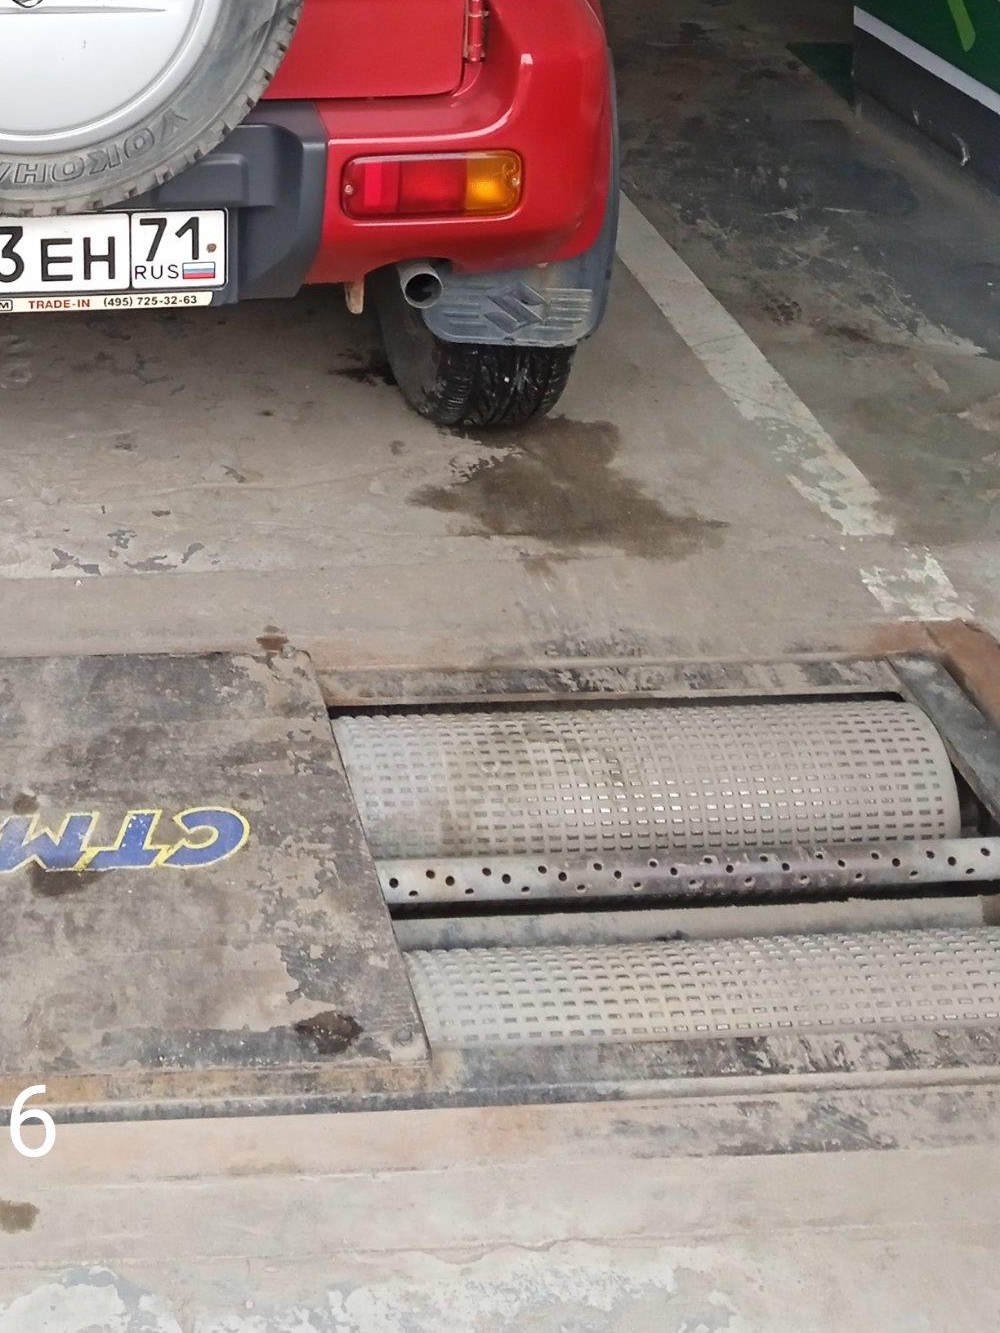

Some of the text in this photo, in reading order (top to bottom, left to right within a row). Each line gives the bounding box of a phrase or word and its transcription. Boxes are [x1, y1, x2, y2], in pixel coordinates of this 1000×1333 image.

[140, 216, 200, 262] 71
[134, 264, 179, 280] RUS
[28, 298, 91, 310] TRADE-IN
[103, 296, 133, 307] (495)
[137, 294, 198, 306] 725-32-63
